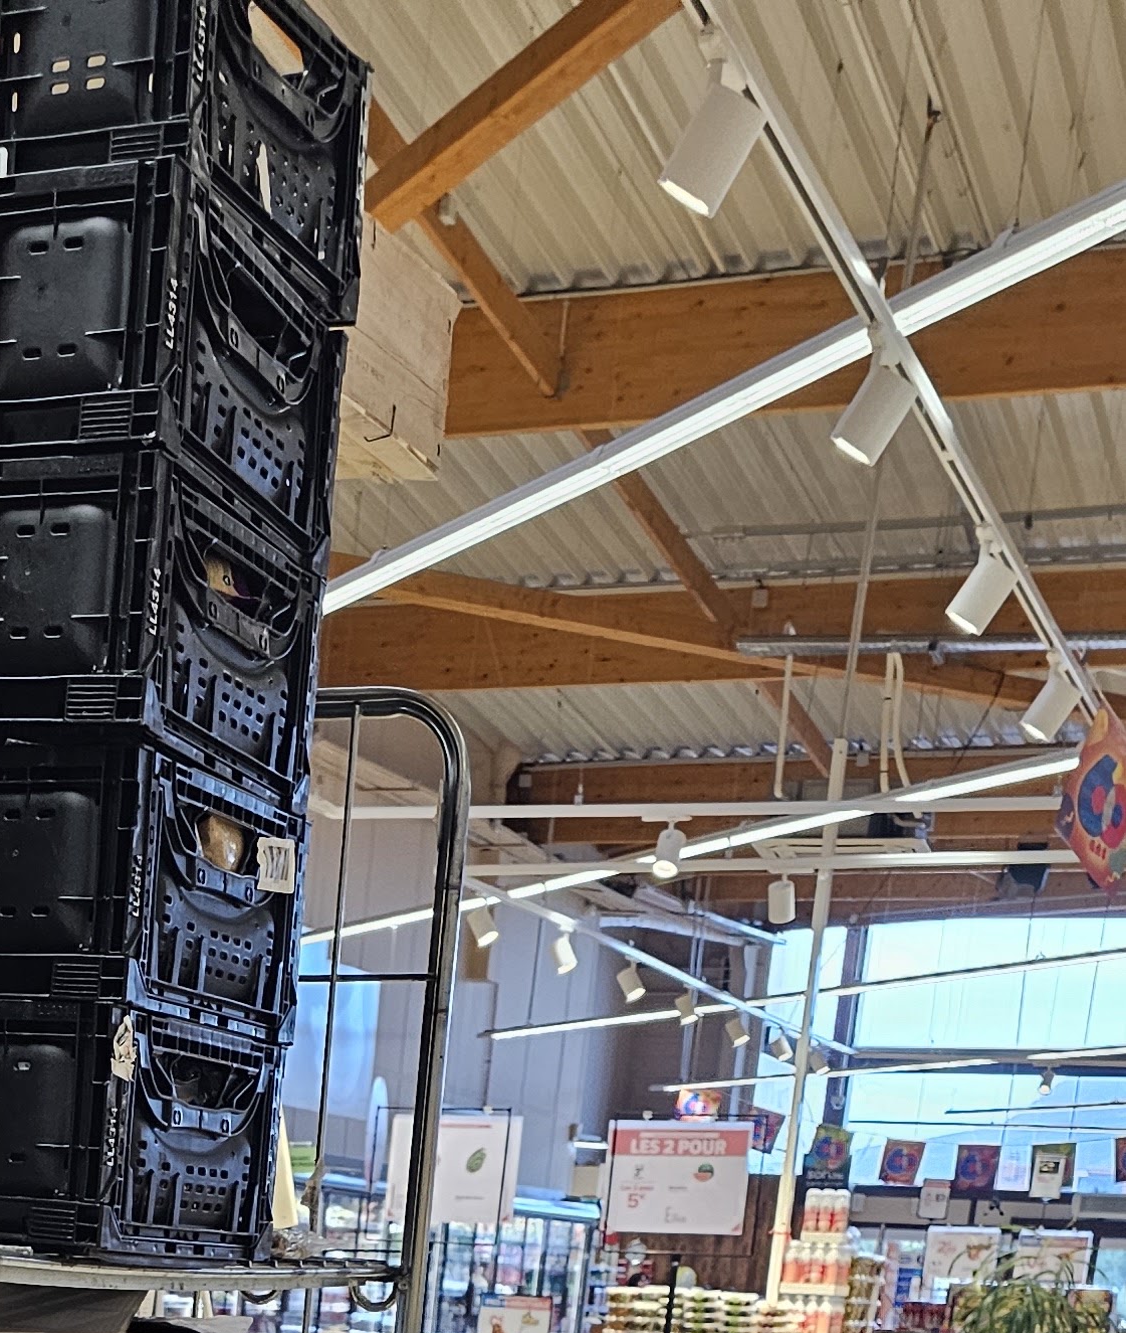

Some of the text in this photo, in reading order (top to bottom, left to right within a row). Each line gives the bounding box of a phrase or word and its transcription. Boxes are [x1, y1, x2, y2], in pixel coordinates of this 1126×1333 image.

[197, 6, 207, 83] LL4314
[165, 277, 178, 350] LL4314
[148, 567, 161, 636] LL4314
[131, 854, 143, 918] LL4314
[106, 1107, 118, 1167] LL4314
[630, 1138, 727, 1156] LES 2 POUR
